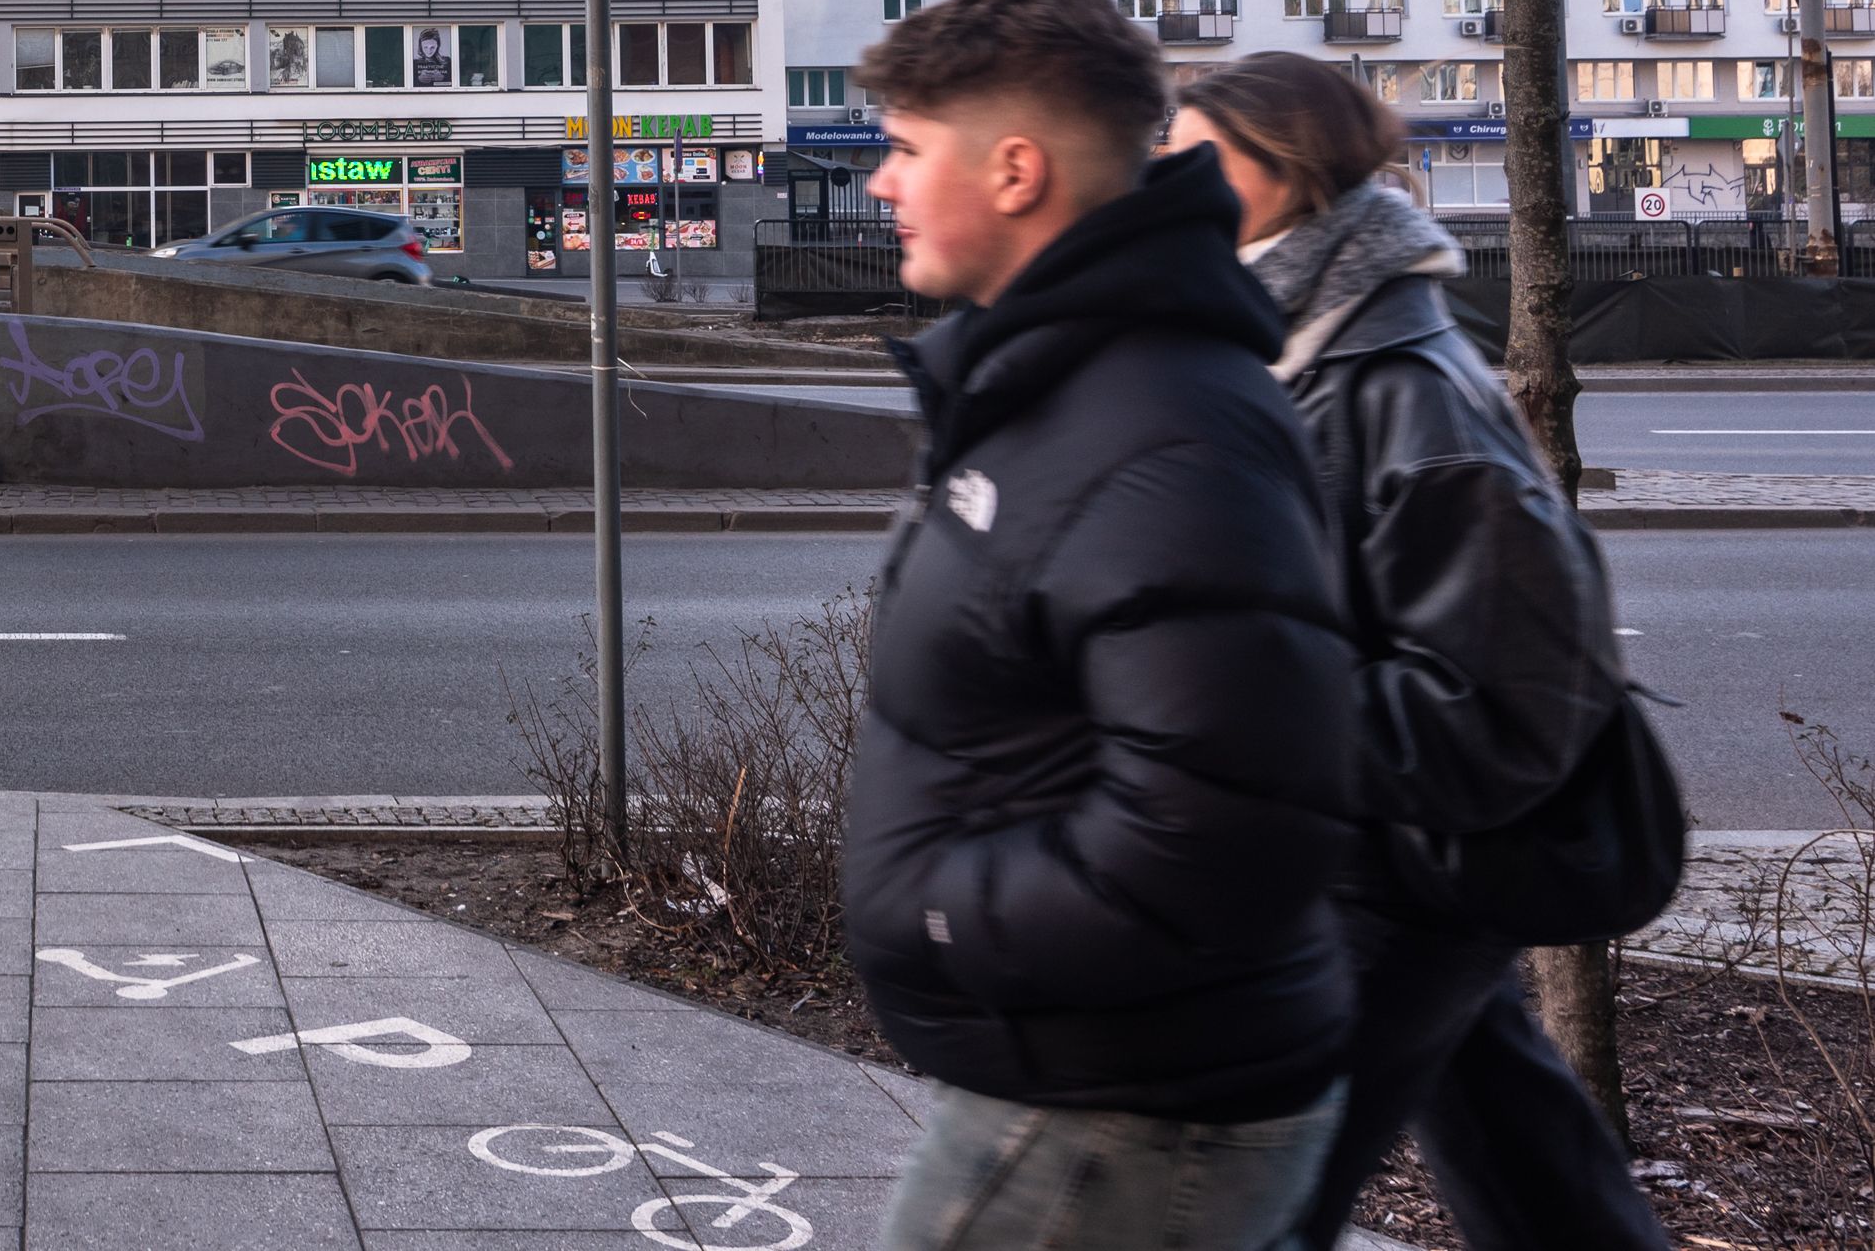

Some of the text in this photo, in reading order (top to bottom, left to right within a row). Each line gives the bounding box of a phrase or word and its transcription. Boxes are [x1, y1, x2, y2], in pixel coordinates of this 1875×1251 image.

[566, 114, 713, 139] MN KEBAB
[1469, 125, 1507, 135] Chirurg
[806, 132, 872, 140] Modelowanie
[627, 194, 656, 205] KEBAB
[1645, 200, 1662, 211] 20
[227, 1016, 472, 1068] P
